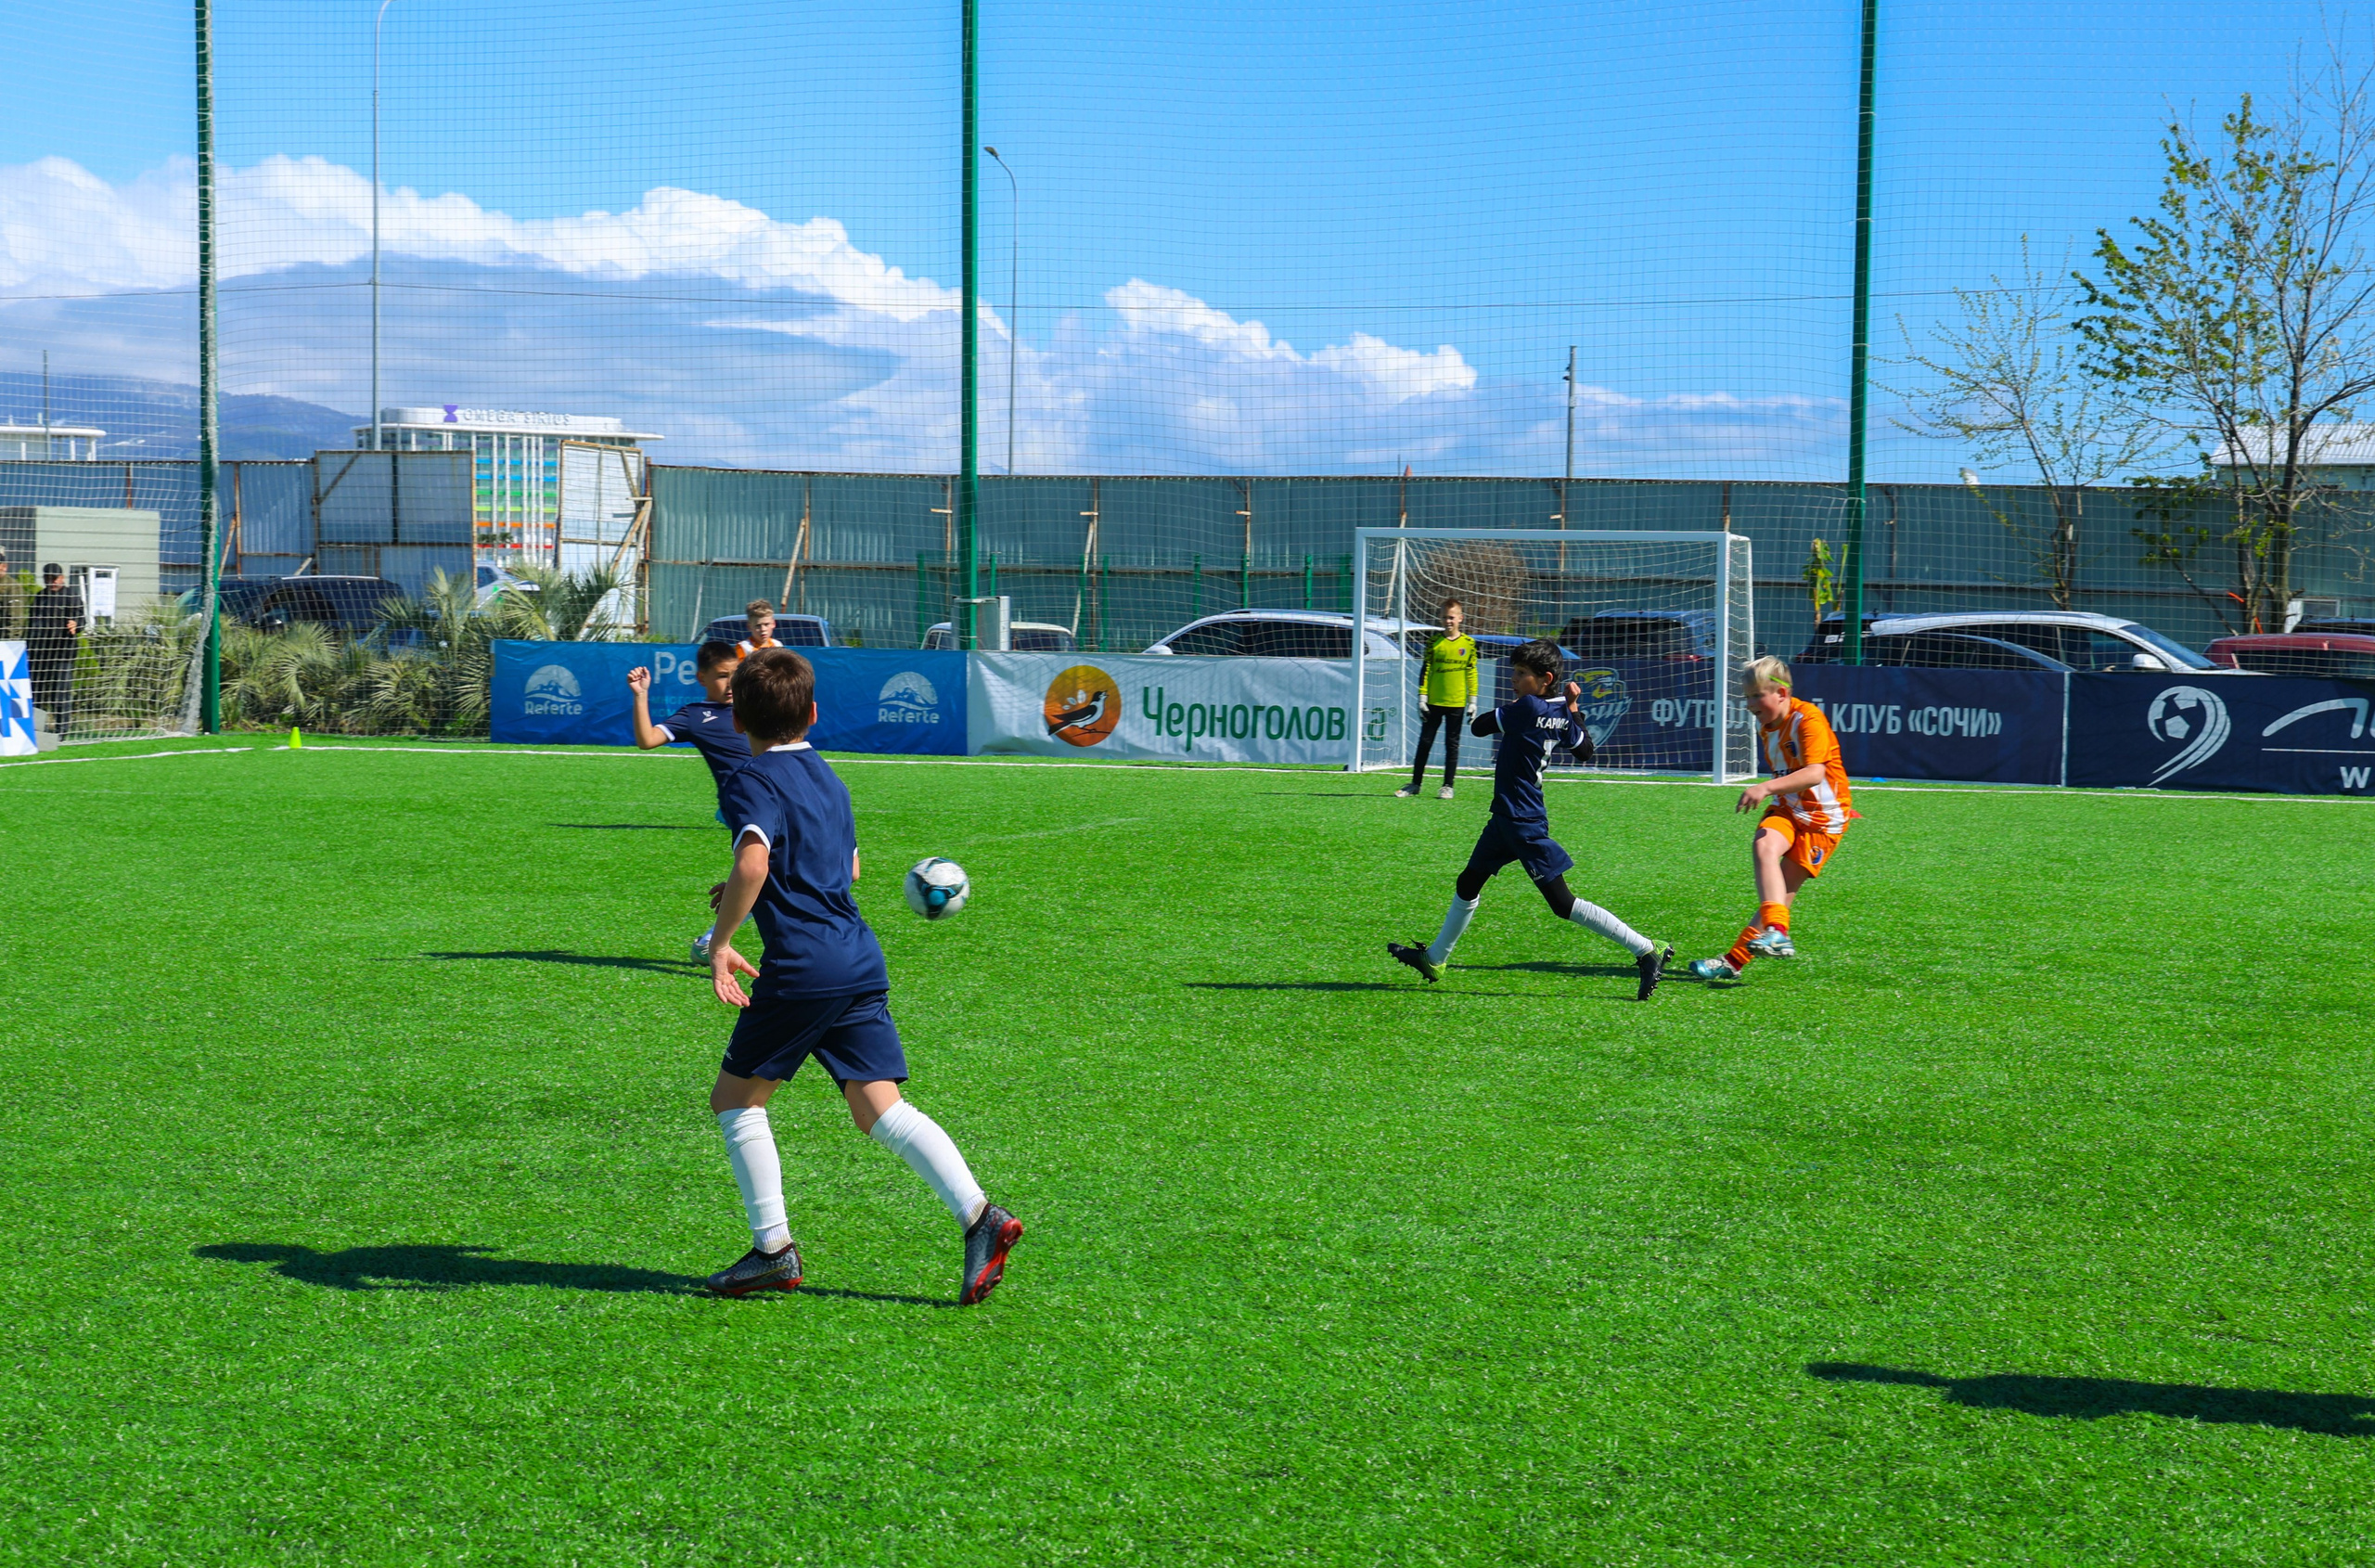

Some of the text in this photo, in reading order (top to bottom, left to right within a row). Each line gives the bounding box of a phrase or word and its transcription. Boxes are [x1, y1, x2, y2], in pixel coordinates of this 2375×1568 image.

[463, 408, 571, 426] OMEGA SIRIUS
[524, 700, 583, 715] Referte
[878, 708, 940, 723] Referte
[1143, 686, 1385, 752] Черноголова
[1831, 702, 1901, 735] КЛУБ
[1907, 706, 2002, 738] «СОЧИ»
